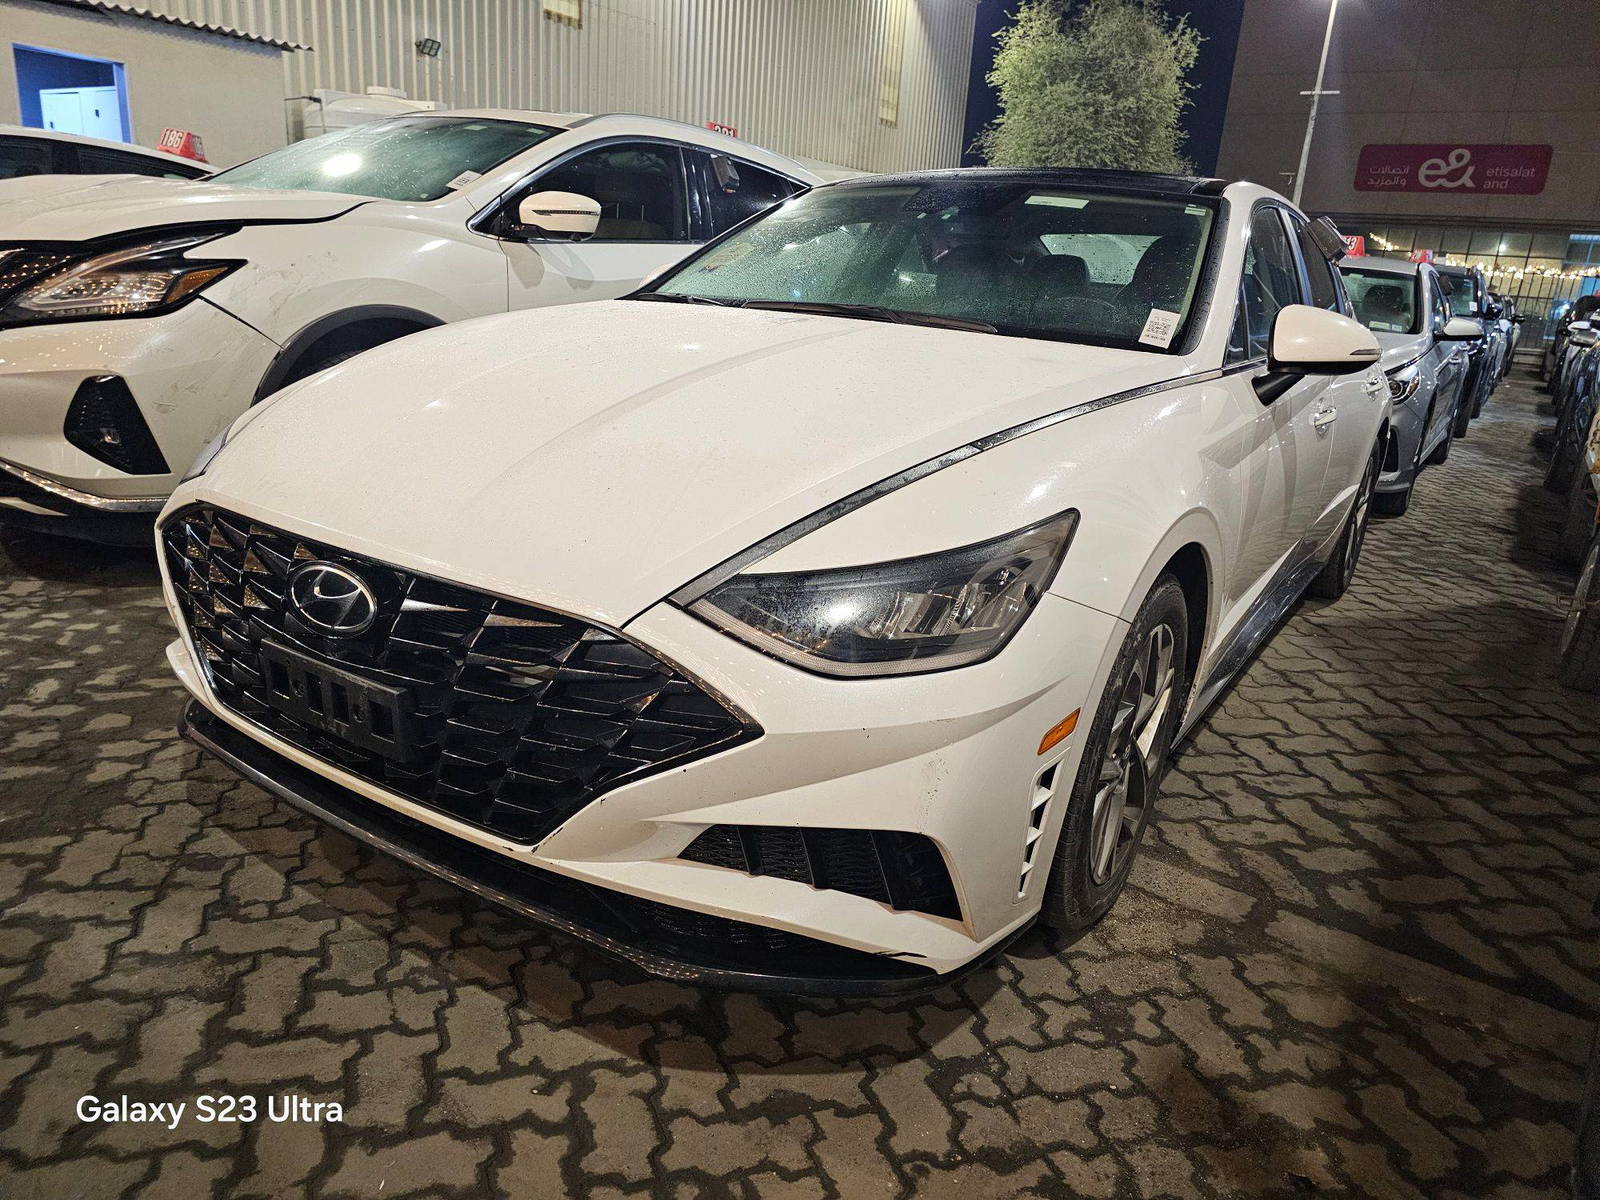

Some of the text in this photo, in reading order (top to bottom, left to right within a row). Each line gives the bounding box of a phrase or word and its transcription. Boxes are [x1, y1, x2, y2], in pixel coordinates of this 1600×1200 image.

[162, 128, 183, 148] 186
[1369, 165, 1409, 175] اتصالات
[1486, 166, 1536, 178] etisalat
[1367, 176, 1407, 187] والمزيد
[1483, 179, 1509, 190] and
